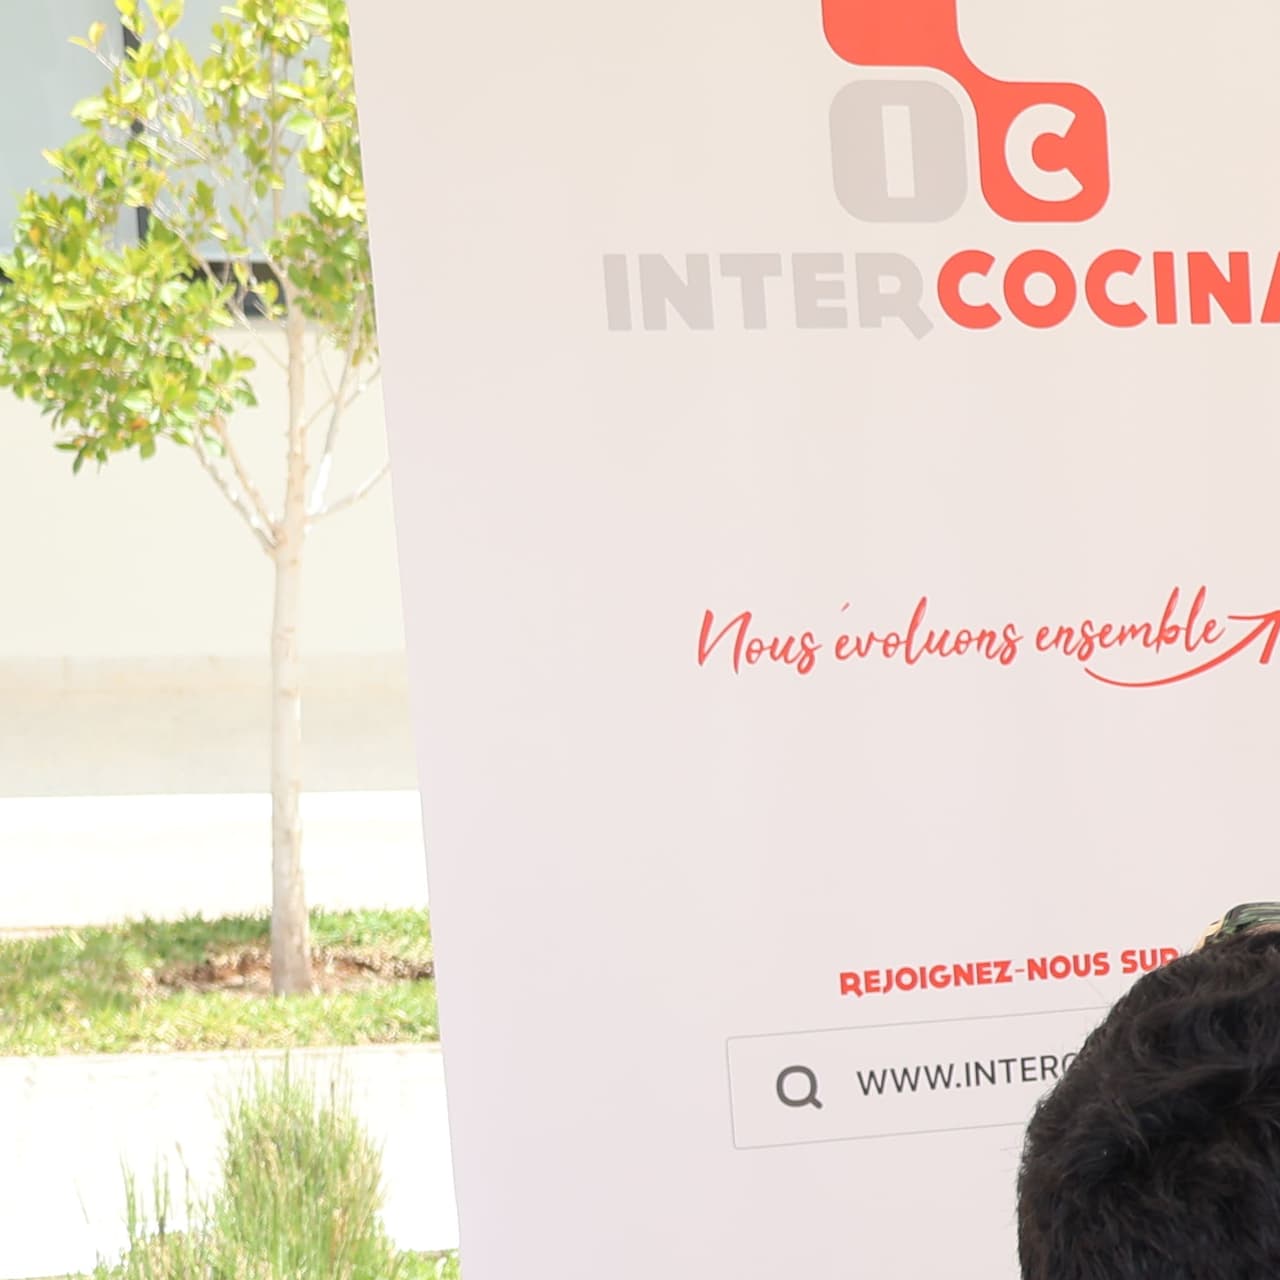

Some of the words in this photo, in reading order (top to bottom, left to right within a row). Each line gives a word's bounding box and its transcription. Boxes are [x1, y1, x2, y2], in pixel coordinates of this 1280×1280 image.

[697, 608, 821, 676] Nous
[834, 596, 1022, 668] évoluons
[1035, 586, 1225, 663] ensemble
[839, 951, 1110, 998] REJOIGNEZ-NOUS
